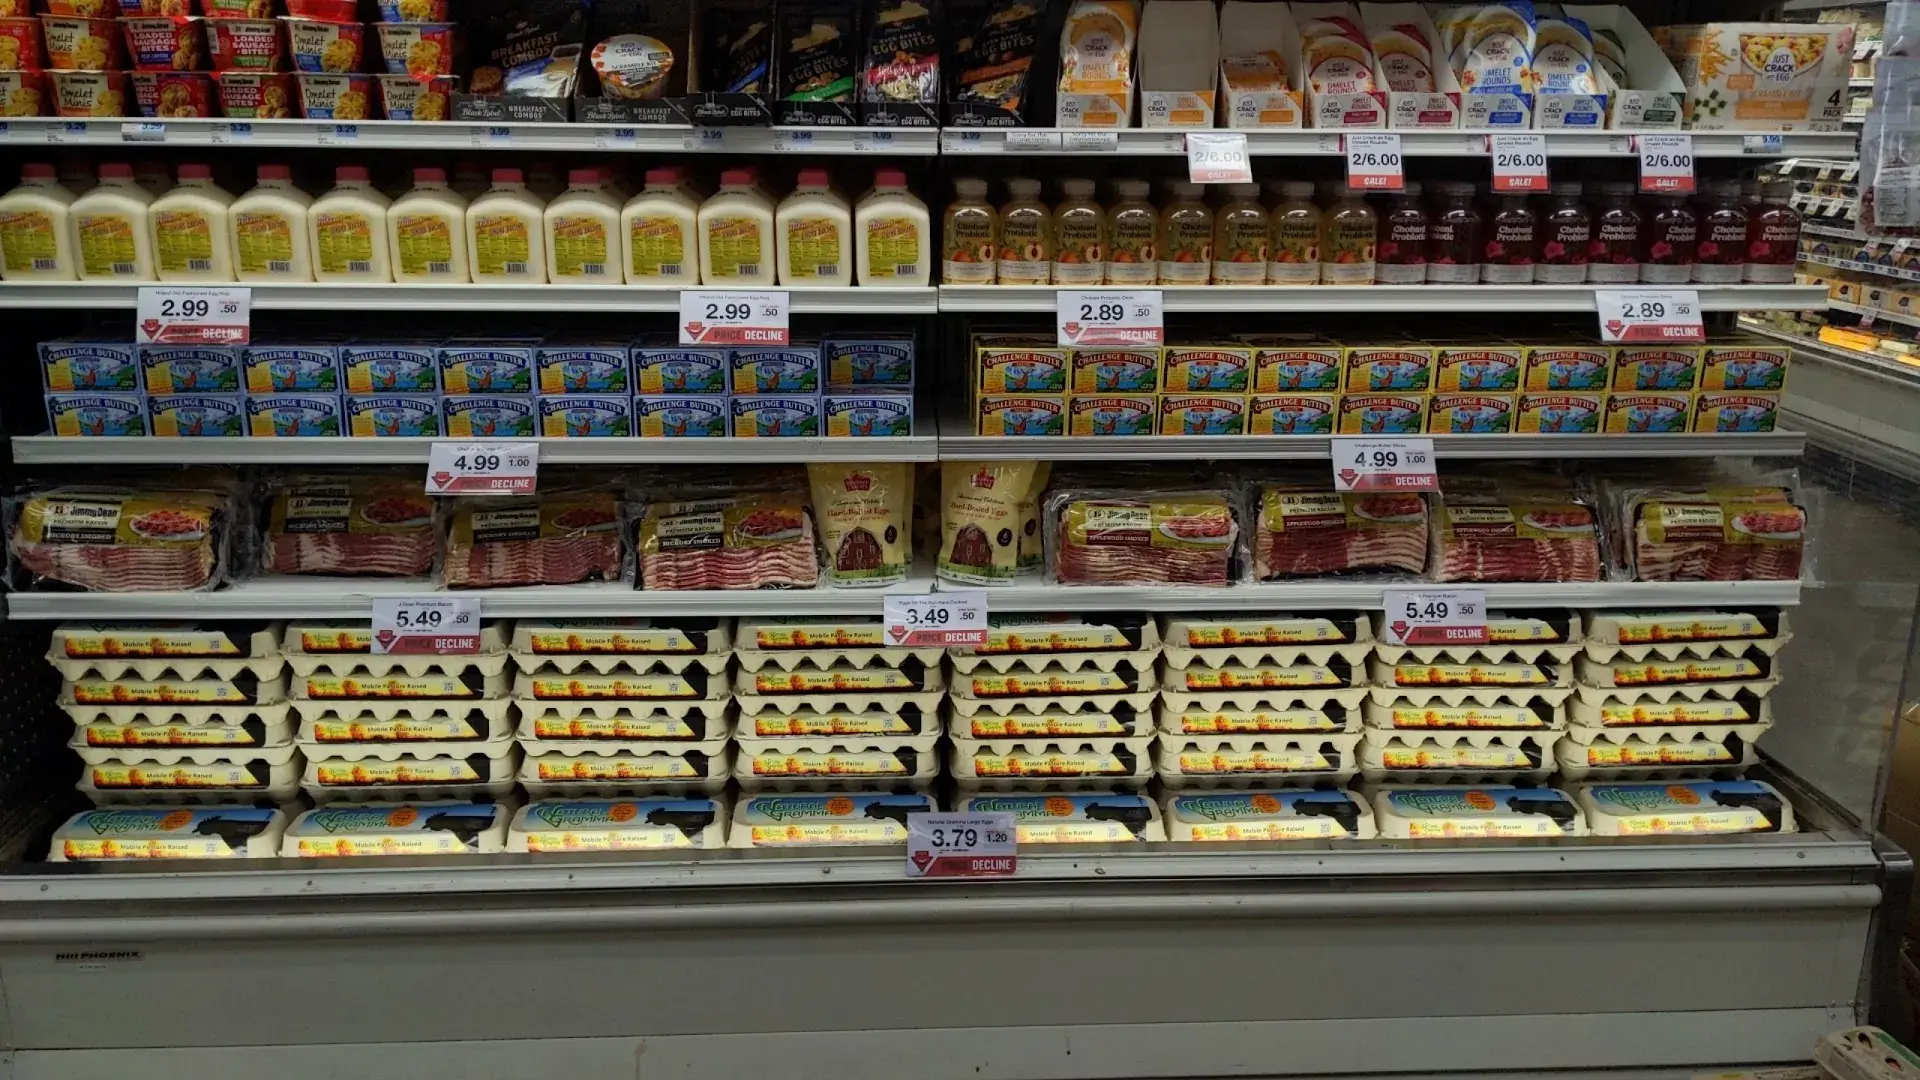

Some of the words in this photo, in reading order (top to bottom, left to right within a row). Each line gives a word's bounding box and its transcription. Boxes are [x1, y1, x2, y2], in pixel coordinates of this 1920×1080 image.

[133, 32, 172, 40] LOADED
[233, 35, 273, 43] LOADED
[294, 35, 325, 47] Omelet
[133, 39, 176, 47] SAUSAGE
[232, 42, 275, 50] SAUSAGE
[872, 43, 897, 56] EGG
[899, 36, 935, 51] BITES
[296, 45, 323, 55] Minis
[1772, 55, 1790, 64] JUST
[788, 69, 814, 84] EGG
[815, 56, 849, 77] BITES
[1764, 64, 1794, 73] CRACK
[1775, 73, 1790, 81] EGG
[60, 88, 94, 99] Omelet
[305, 89, 336, 100] Omelet
[1827, 89, 1841, 107] 4
[64, 98, 92, 107] Minis
[308, 99, 334, 108] Minis
[508, 106, 547, 114] BREAKFAST
[632, 107, 672, 115] BREAKFAST
[1822, 109, 1842, 117] PACK
[514, 112, 543, 120] COMBOS
[638, 114, 667, 122] COMBOS
[66, 122, 86, 131] 3.29
[142, 122, 162, 131] 3.29
[231, 124, 251, 132] 3.29
[336, 125, 356, 133] 3.29
[490, 128, 509, 136] 3.99
[615, 130, 634, 138] 3.99
[703, 131, 722, 139] 3.99
[792, 132, 812, 140] 3.99
[961, 132, 980, 140] 3.99
[1195, 151, 1242, 165] 2/6.00
[1352, 153, 1398, 167] 2/6.00
[1497, 154, 1544, 167] 2/6.00
[1646, 154, 1691, 168] 2/6.00
[1207, 171, 1231, 179] SALE!
[1363, 176, 1386, 185] SALE!
[1508, 177, 1532, 187] SALE!
[1655, 177, 1678, 187] SALE!
[957, 222, 990, 231] Chobani
[1005, 221, 1037, 231] Chobani
[955, 230, 990, 239] Probiotic
[1003, 229, 1038, 238] Probiotic
[161, 299, 209, 318] 2.99
[220, 304, 237, 313] .50
[705, 303, 751, 320] 2.99
[761, 308, 778, 317] .50
[1080, 304, 1124, 321] 2.89
[1135, 308, 1150, 316] .50
[1622, 302, 1665, 318] 2.89
[1675, 306, 1690, 315] .50
[203, 328, 243, 339] DECLINE
[715, 330, 743, 341] PRICE
[745, 330, 783, 341] DECLINE
[1120, 330, 1158, 340] DECLINE
[1663, 326, 1699, 337] DECLINE
[347, 350, 394, 364] CHALLENGE
[397, 350, 429, 365] BUTTER
[640, 352, 686, 366] CHALLENGE
[688, 352, 719, 367] BUTTER
[986, 352, 1031, 366] CHALLENGE
[1032, 353, 1061, 367] BUTTER
[1532, 351, 1577, 365] CHALLENGE
[1577, 352, 1605, 366] BUTTER
[829, 400, 874, 414] CHALLENGE
[875, 400, 908, 415] BUTTER
[453, 455, 500, 471] 4.99
[508, 458, 530, 467] 1.00
[1355, 451, 1398, 467] 4.99
[1405, 455, 1426, 464] 1.00
[491, 478, 530, 489] DECLINE
[1395, 475, 1433, 486] DECLINE
[950, 501, 991, 515] Hard-Boiled
[679, 516, 701, 528] Jimmy
[703, 515, 722, 525] Dean
[695, 525, 715, 533] BACON
[662, 538, 692, 547] HICKORY
[693, 537, 722, 547] SMOKED
[1406, 602, 1449, 618] 5.49
[1458, 606, 1474, 615] .50
[397, 610, 442, 627] 5.49
[452, 615, 469, 624] .50
[907, 608, 949, 623] 3.49
[959, 612, 974, 620] .50
[945, 632, 982, 642] DECLINE
[1239, 630, 1259, 638] Mobile
[1447, 629, 1483, 639] DECLINE
[171, 640, 192, 648] Raised
[435, 638, 474, 649] DECLINE
[764, 797, 825, 811] NATURAL
[778, 809, 835, 821] GRAMMA
[931, 829, 978, 848] 3.79
[986, 833, 1008, 843] 1.20
[972, 859, 1012, 871] DECLINE
[80, 951, 140, 960] PHOENIX
